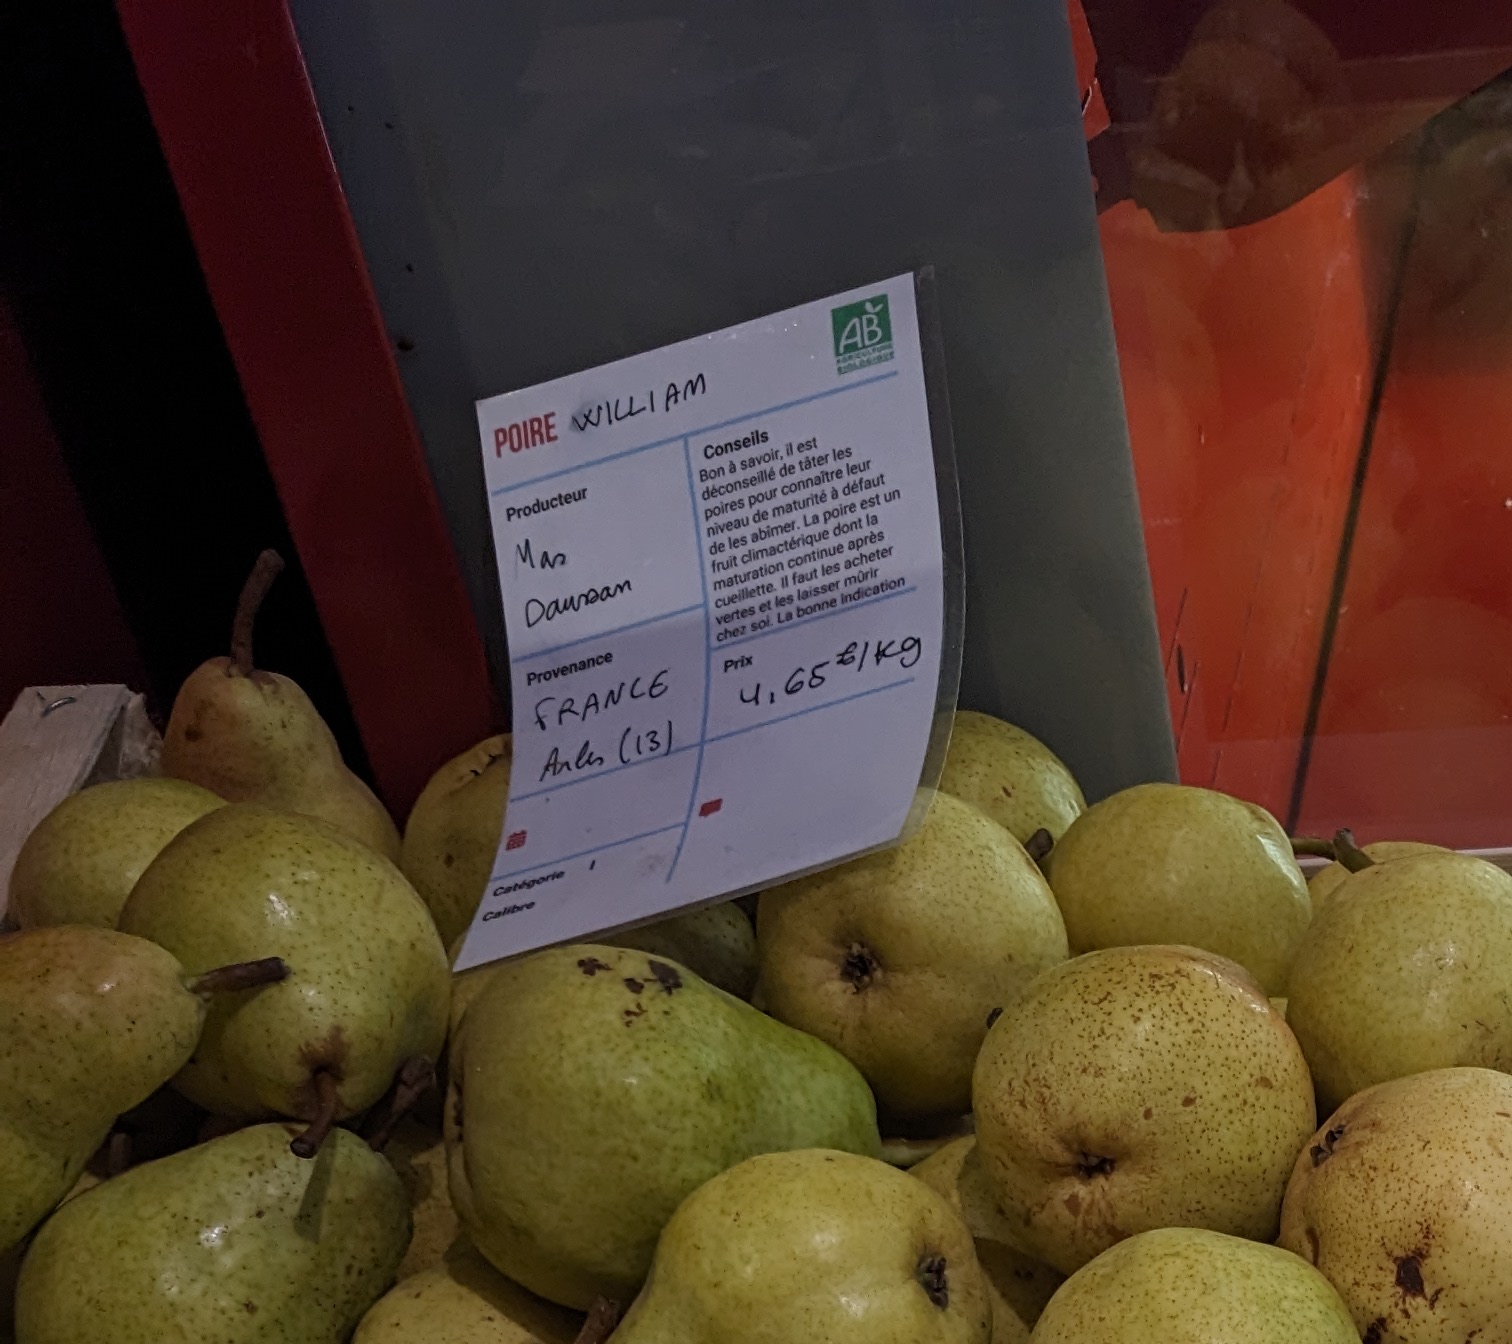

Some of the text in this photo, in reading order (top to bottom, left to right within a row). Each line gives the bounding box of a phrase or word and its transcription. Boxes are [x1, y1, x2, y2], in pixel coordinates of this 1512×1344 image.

[839, 313, 882, 354] AB
[493, 372, 707, 459] POIRE WILLIAM
[698, 436, 818, 483] Bon à savoir, il est
[702, 429, 770, 460] Conseils
[701, 447, 853, 502] déconseillé de tâter les
[703, 459, 871, 523] poires pour connaître leur
[505, 487, 588, 523] Producteur
[525, 651, 614, 687] Provenance
[723, 655, 754, 674] Prix
[533, 669, 669, 732] FRANCE
[619, 719, 673, 765] (13)
